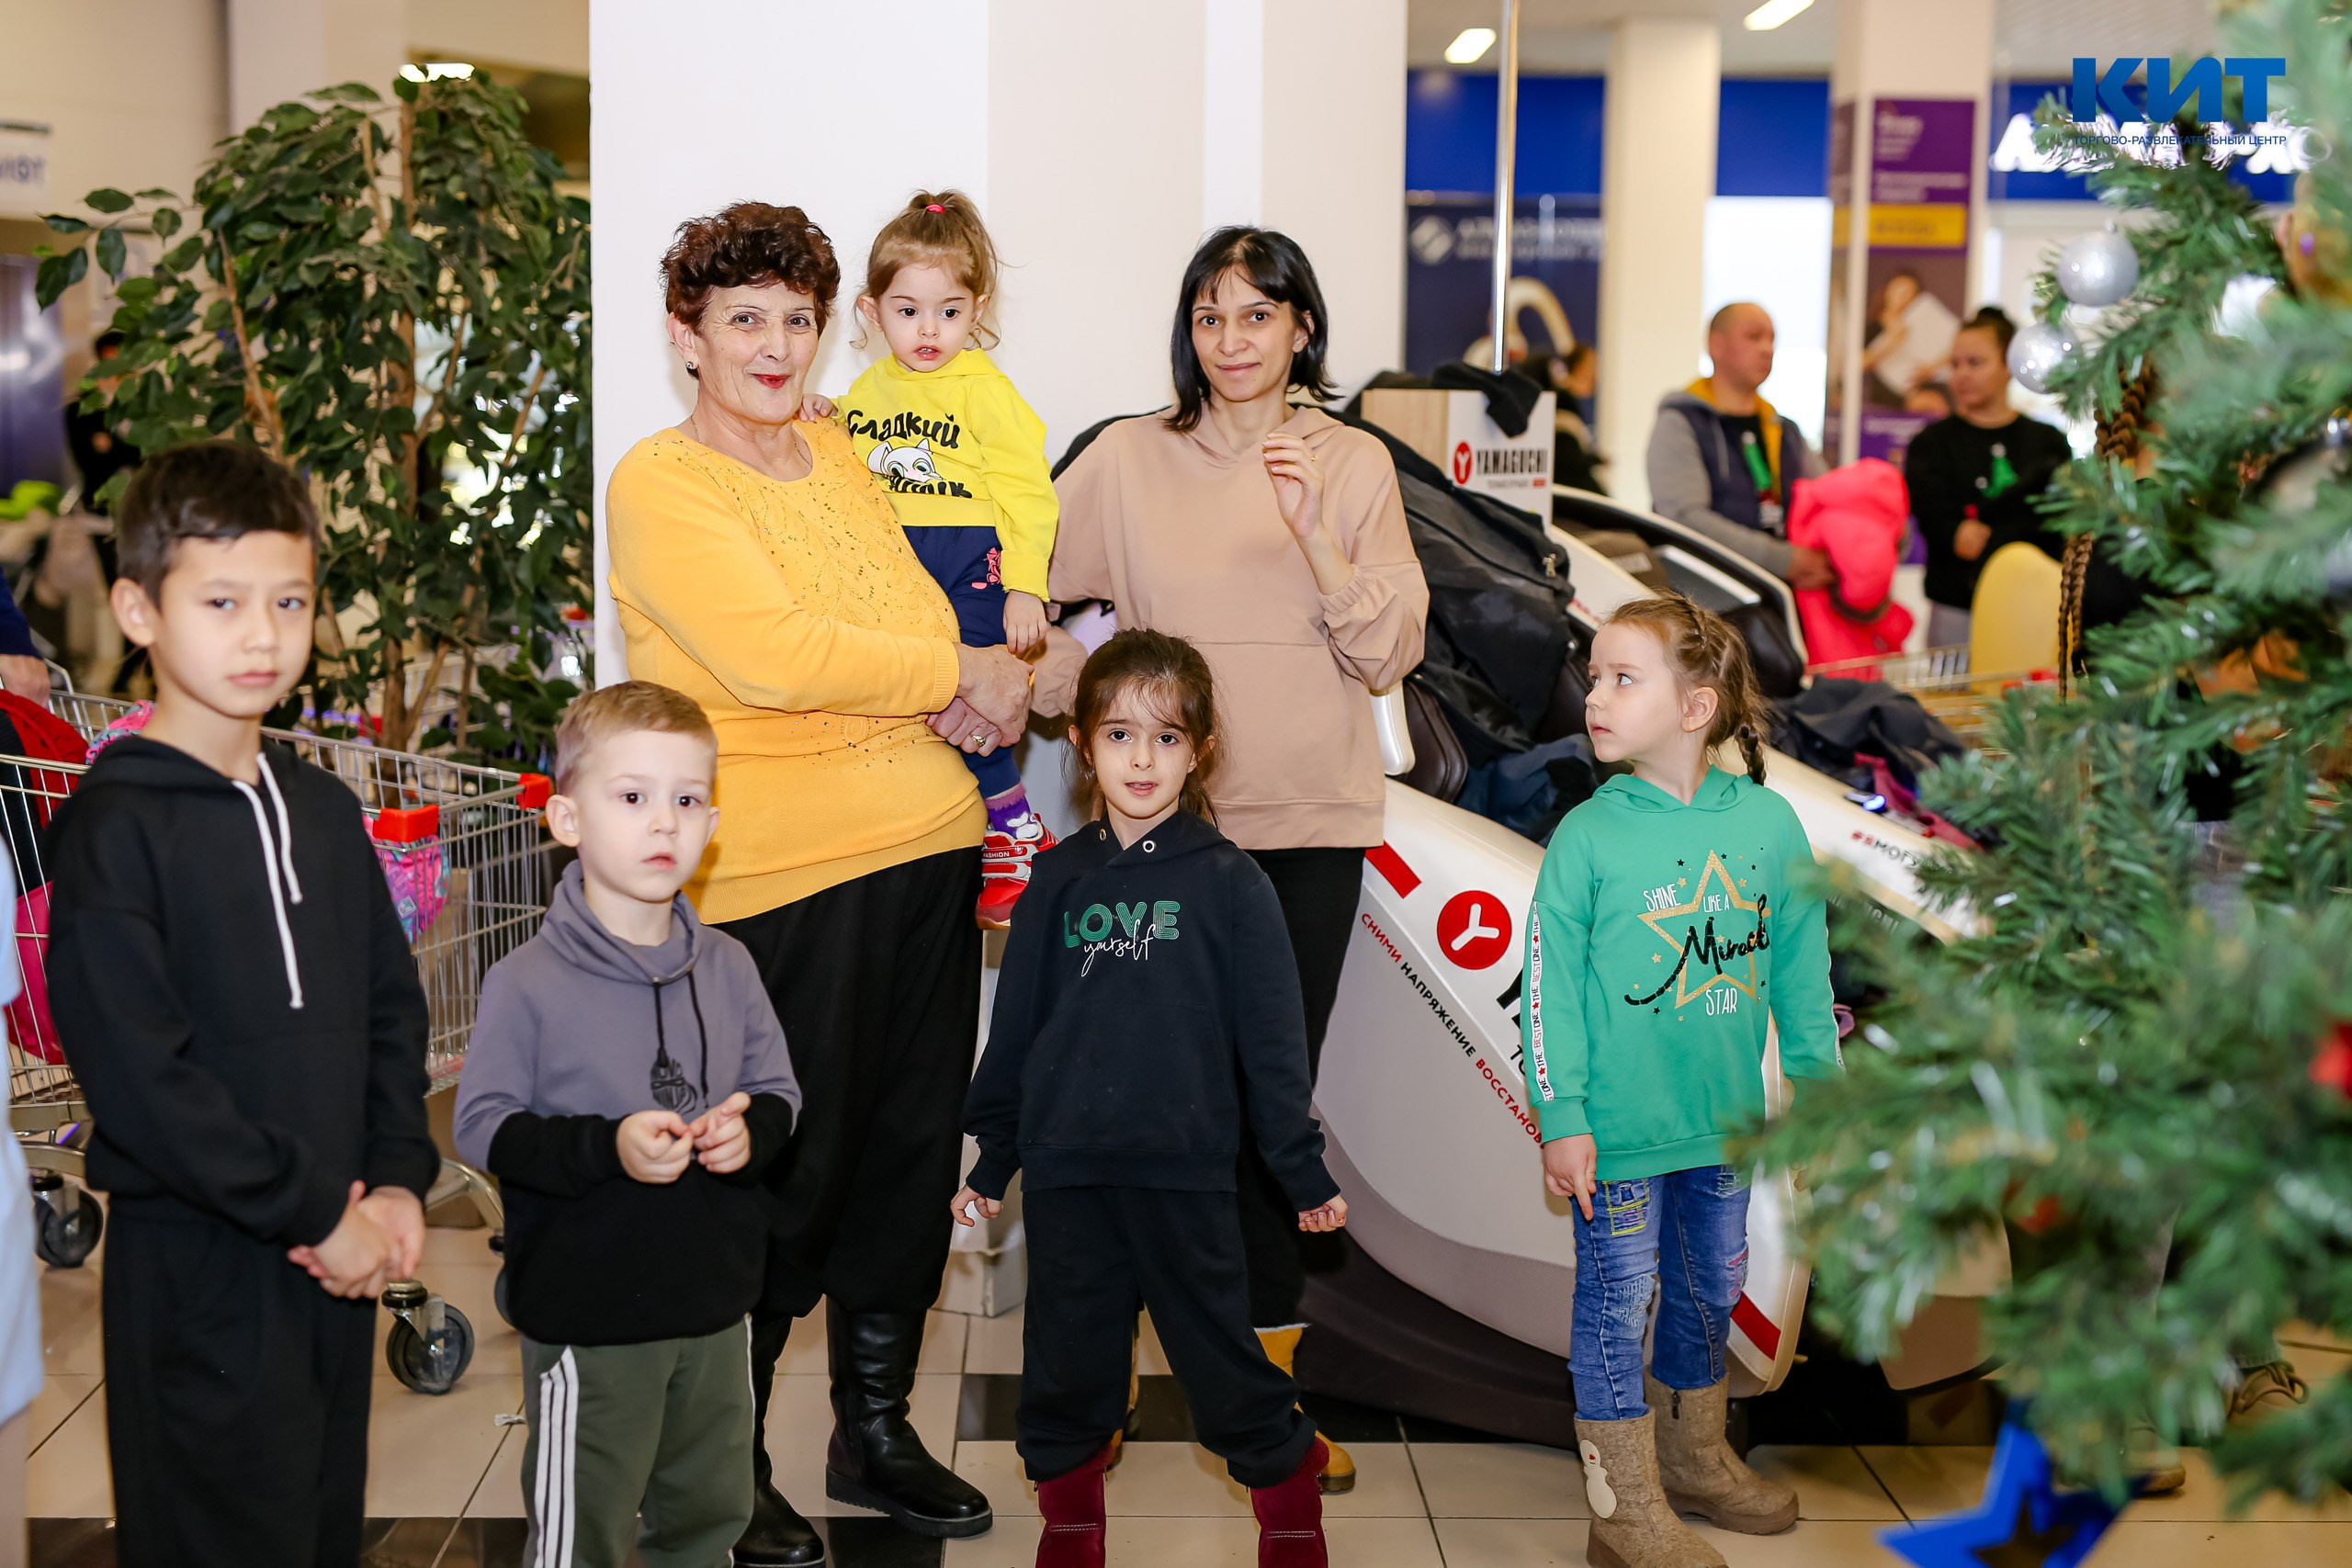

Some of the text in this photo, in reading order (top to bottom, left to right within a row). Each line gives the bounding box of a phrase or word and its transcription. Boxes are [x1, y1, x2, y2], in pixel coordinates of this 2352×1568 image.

[846, 410, 961, 449] Сладкий
[1476, 448, 1547, 474] YAMAGUCHI
[1643, 883, 1681, 912] SHINE
[1702, 893, 1730, 913] LIKE A
[1063, 900, 1181, 949] LOVE
[1080, 919, 1157, 977] yourself
[1532, 945, 1541, 962] ONE
[1532, 963, 1541, 983] BEST
[1531, 986, 1540, 1002] THE
[1705, 987, 1738, 1017] STAR
[1532, 1011, 1541, 1028] ONE
[1361, 912, 1544, 1150] СНИМИ НАПРЯЖЕНИЕ ВОССТАНОВ
[1533, 1029, 1543, 1049] BEST
[1535, 1052, 1545, 1067] THE
[1538, 1077, 1551, 1093] ONE
